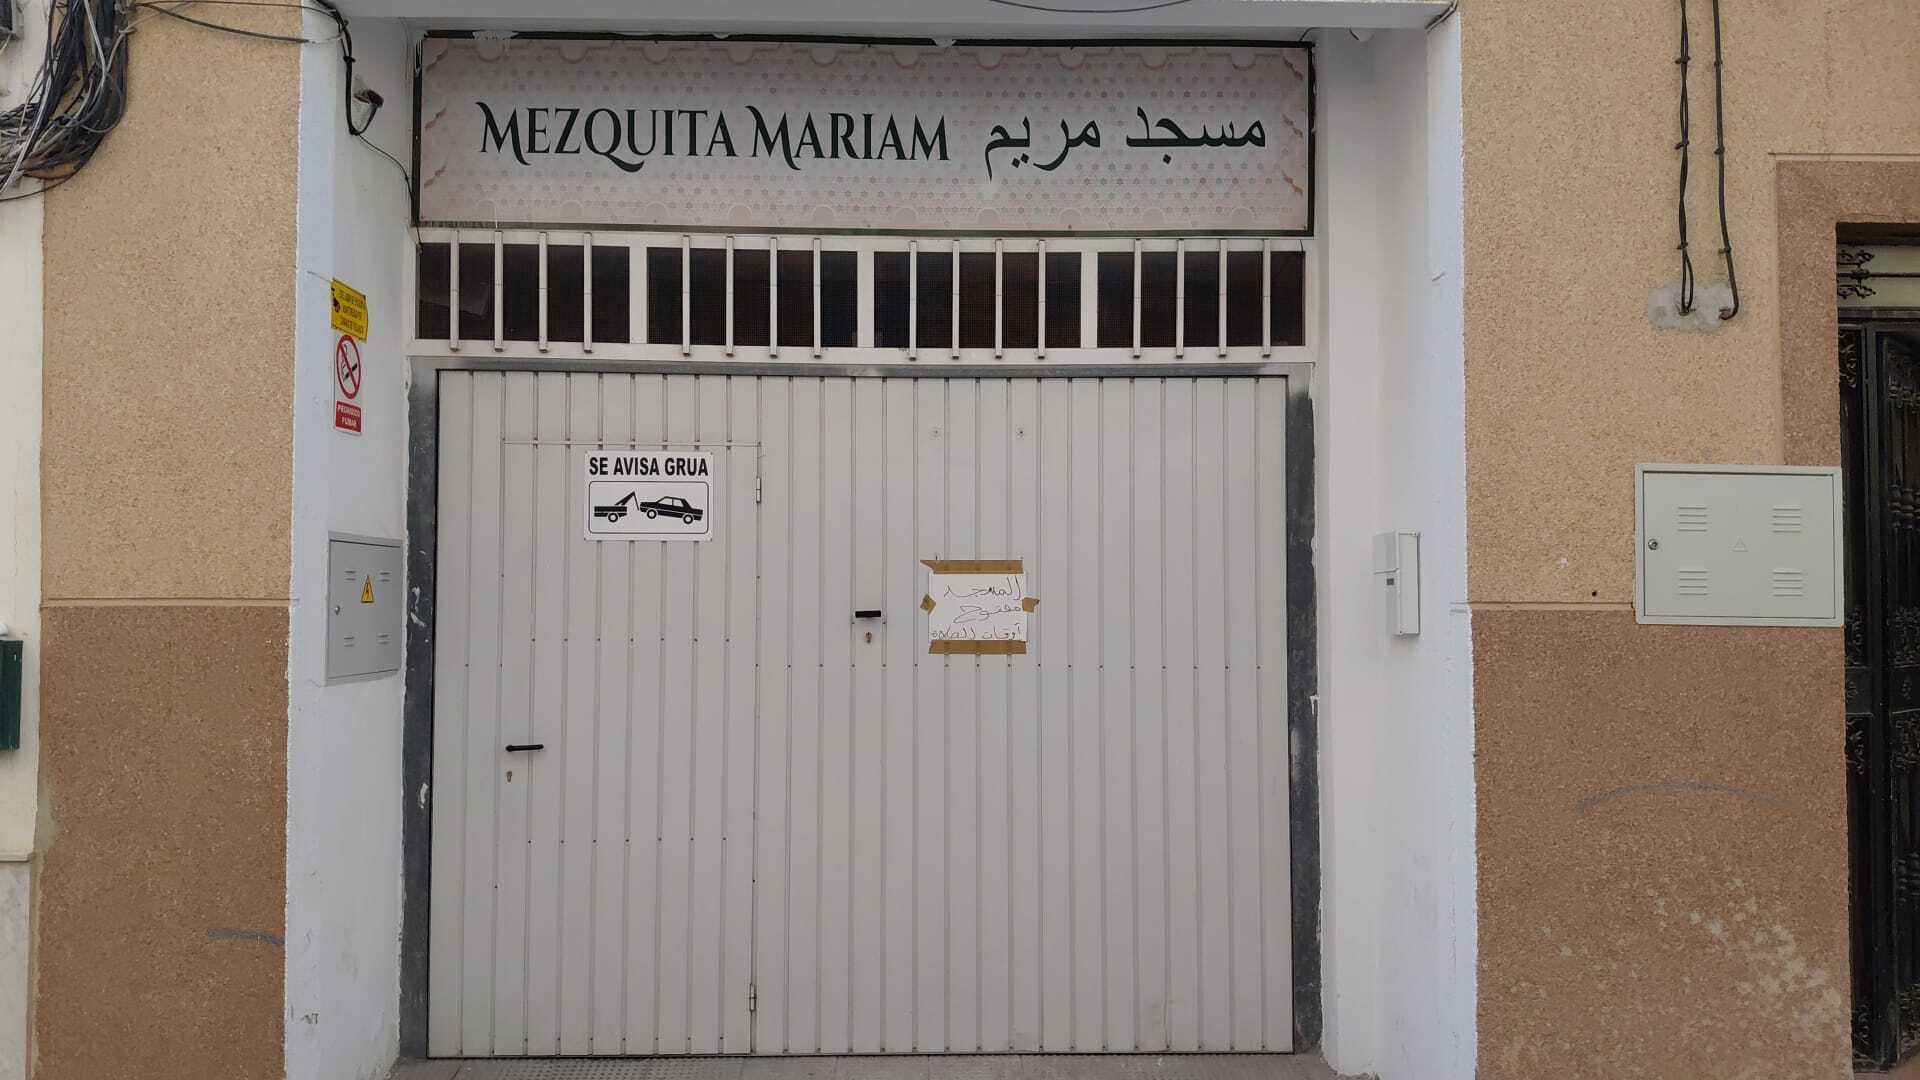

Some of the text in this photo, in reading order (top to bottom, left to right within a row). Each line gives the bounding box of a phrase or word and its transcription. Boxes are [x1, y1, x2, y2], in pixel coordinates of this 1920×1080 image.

[475, 102, 950, 172] MEZQUITA MARIAM
[985, 107, 1267, 180] مسجد مريم
[589, 457, 708, 476] SE AVISA GRUA
